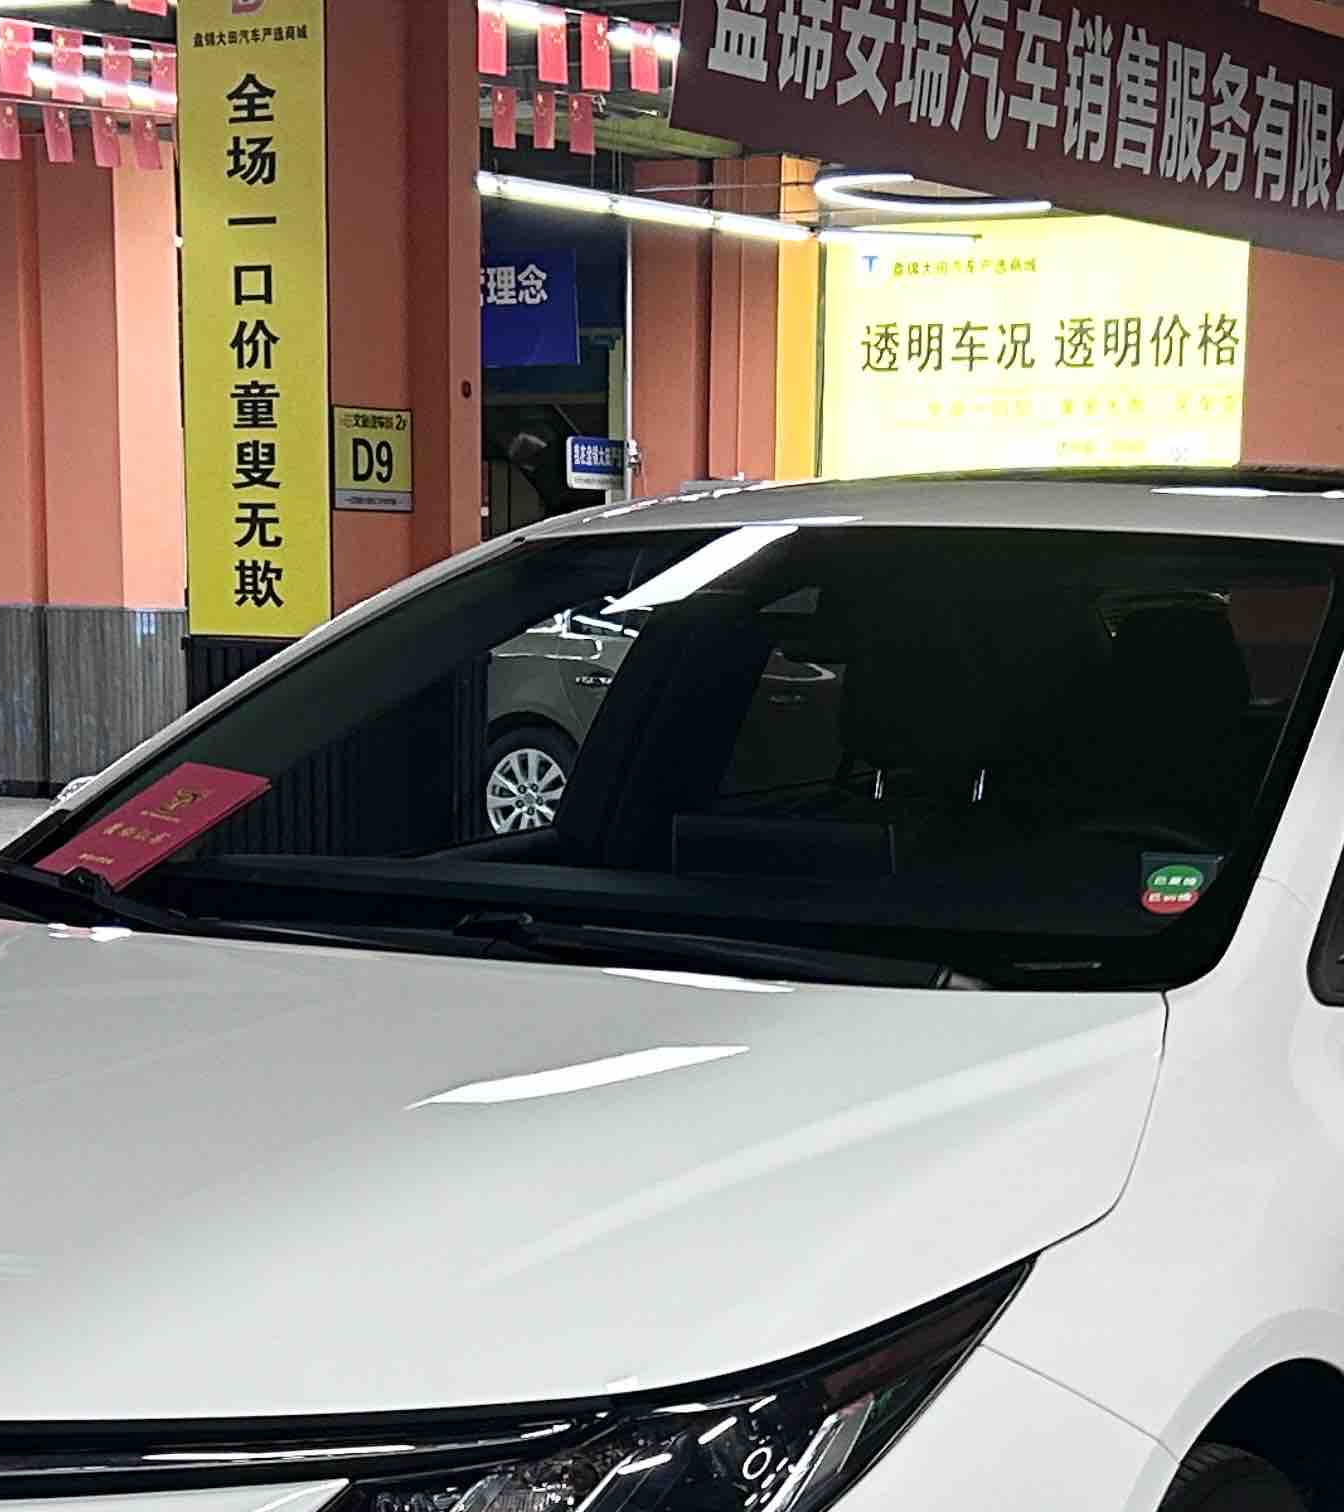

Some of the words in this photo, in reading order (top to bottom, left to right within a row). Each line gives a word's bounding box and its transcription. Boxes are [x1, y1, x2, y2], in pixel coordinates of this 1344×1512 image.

[480, 264, 548, 306] 理念
[226, 73, 284, 608] 全场一口价童叟无欺
[861, 320, 1035, 372] 透明车况
[1055, 313, 1239, 369] 透明价格
[351, 437, 393, 484] D9
